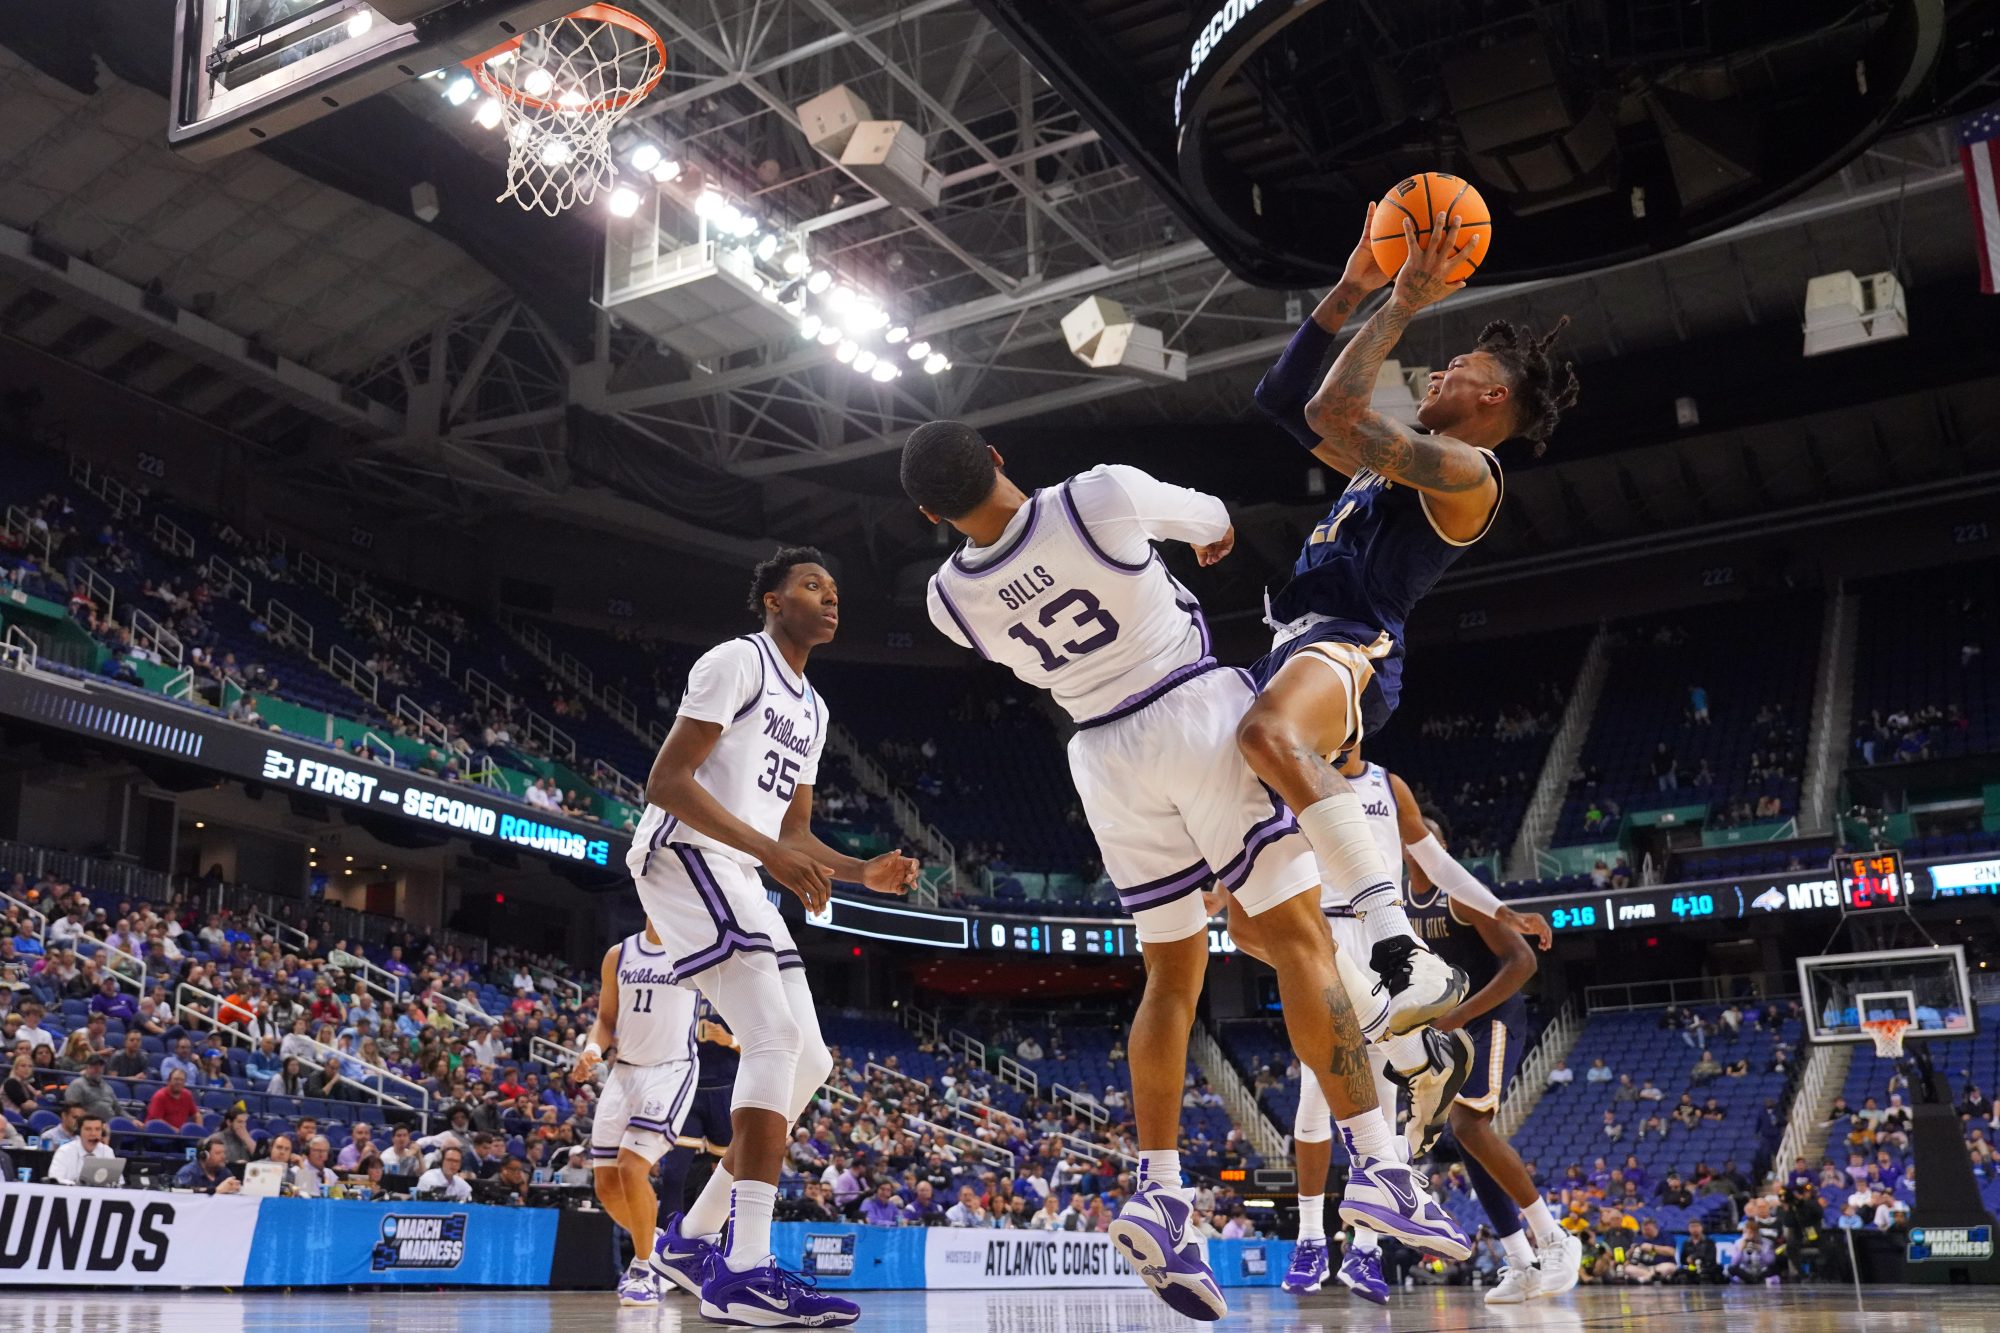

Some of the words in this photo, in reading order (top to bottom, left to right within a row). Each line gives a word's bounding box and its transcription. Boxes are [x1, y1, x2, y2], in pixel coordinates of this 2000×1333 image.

[998, 565, 1055, 611] SILLS
[1702, 567, 1733, 586] 222
[1008, 588, 1120, 672] 13
[758, 749, 801, 803] 35
[296, 758, 378, 804] FIRST
[402, 787, 497, 837] SECOND
[499, 813, 587, 861] ROUNDS
[1551, 906, 1596, 929] 3-16
[1671, 894, 1714, 918] 4-10
[991, 924, 1006, 947] 0
[1426, 916, 1450, 939] STATE
[1061, 928, 1076, 951] 2
[621, 968, 679, 986] Wildcats
[633, 989, 653, 1013] 11
[396, 1218, 442, 1240] MARCH
[1924, 1229, 1968, 1244] MARCH
[399, 1240, 463, 1261] MADNESS
[812, 1237, 842, 1253] MARCH
[1931, 1241, 1990, 1256] MADNESS
[816, 1254, 854, 1270] MADNESS
[945, 1251, 971, 1264] HOSTED
[973, 1251, 982, 1264] BY
[985, 1240, 1057, 1276] ATLANTIC
[1063, 1242, 1108, 1275] COAST
